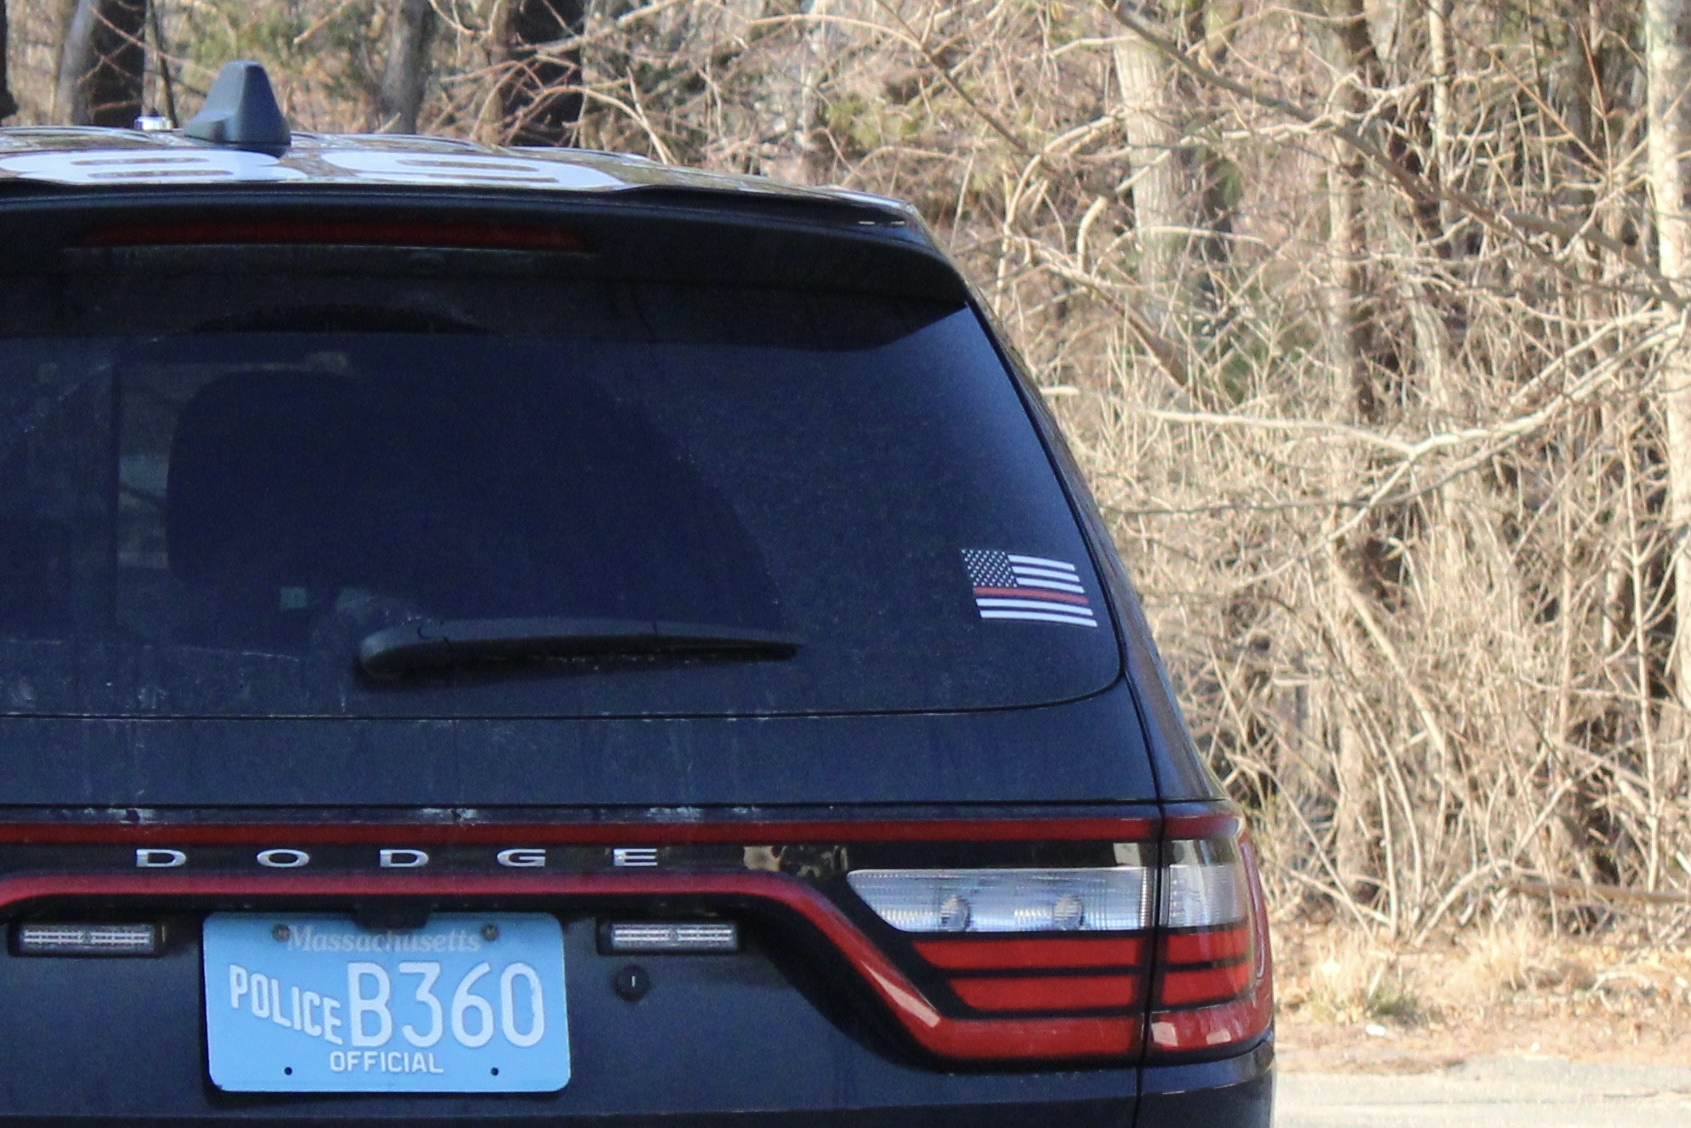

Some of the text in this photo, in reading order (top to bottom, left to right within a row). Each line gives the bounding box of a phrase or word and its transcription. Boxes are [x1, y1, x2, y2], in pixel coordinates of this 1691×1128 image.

[135, 848, 659, 868] DODGE
[287, 925, 480, 952] Massachusetts
[229, 961, 545, 1048] POLICE B360
[329, 1051, 443, 1073] OFFICIAL
